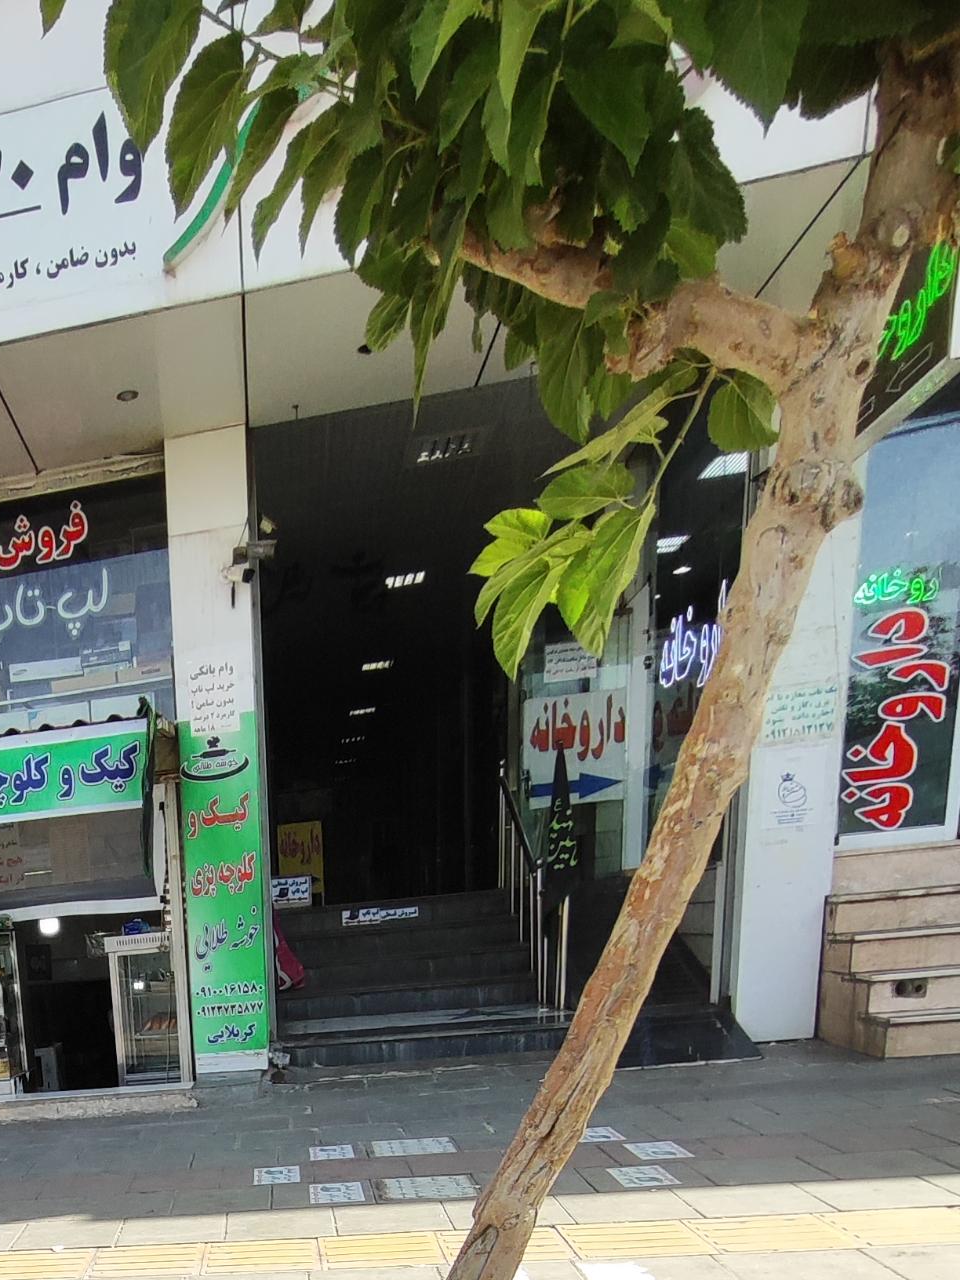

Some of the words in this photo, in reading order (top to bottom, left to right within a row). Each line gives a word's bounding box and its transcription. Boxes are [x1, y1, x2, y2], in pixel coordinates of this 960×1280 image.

[56, 110, 143, 216] وام
[46, 247, 90, 278] ضامن
[94, 240, 137, 268] بدون
[57, 568, 108, 636] لپ
[189, 664, 216, 681] بانکی
[216, 681, 235, 692] خرید
[219, 662, 234, 676] وام
[216, 698, 234, 708] بدون
[841, 606, 950, 830] داروخانه
[530, 692, 626, 762] داروخانه
[58, 765, 75, 800] و
[79, 741, 140, 793] کیک
[188, 811, 198, 839] و
[201, 793, 249, 831] کیک
[280, 827, 320, 865] داروخانه
[192, 864, 216, 897] پزی
[218, 851, 256, 894] کلوچه
[195, 919, 228, 972] طلایی
[230, 905, 260, 950] خوشه
[207, 1023, 256, 1044] کربلایی
